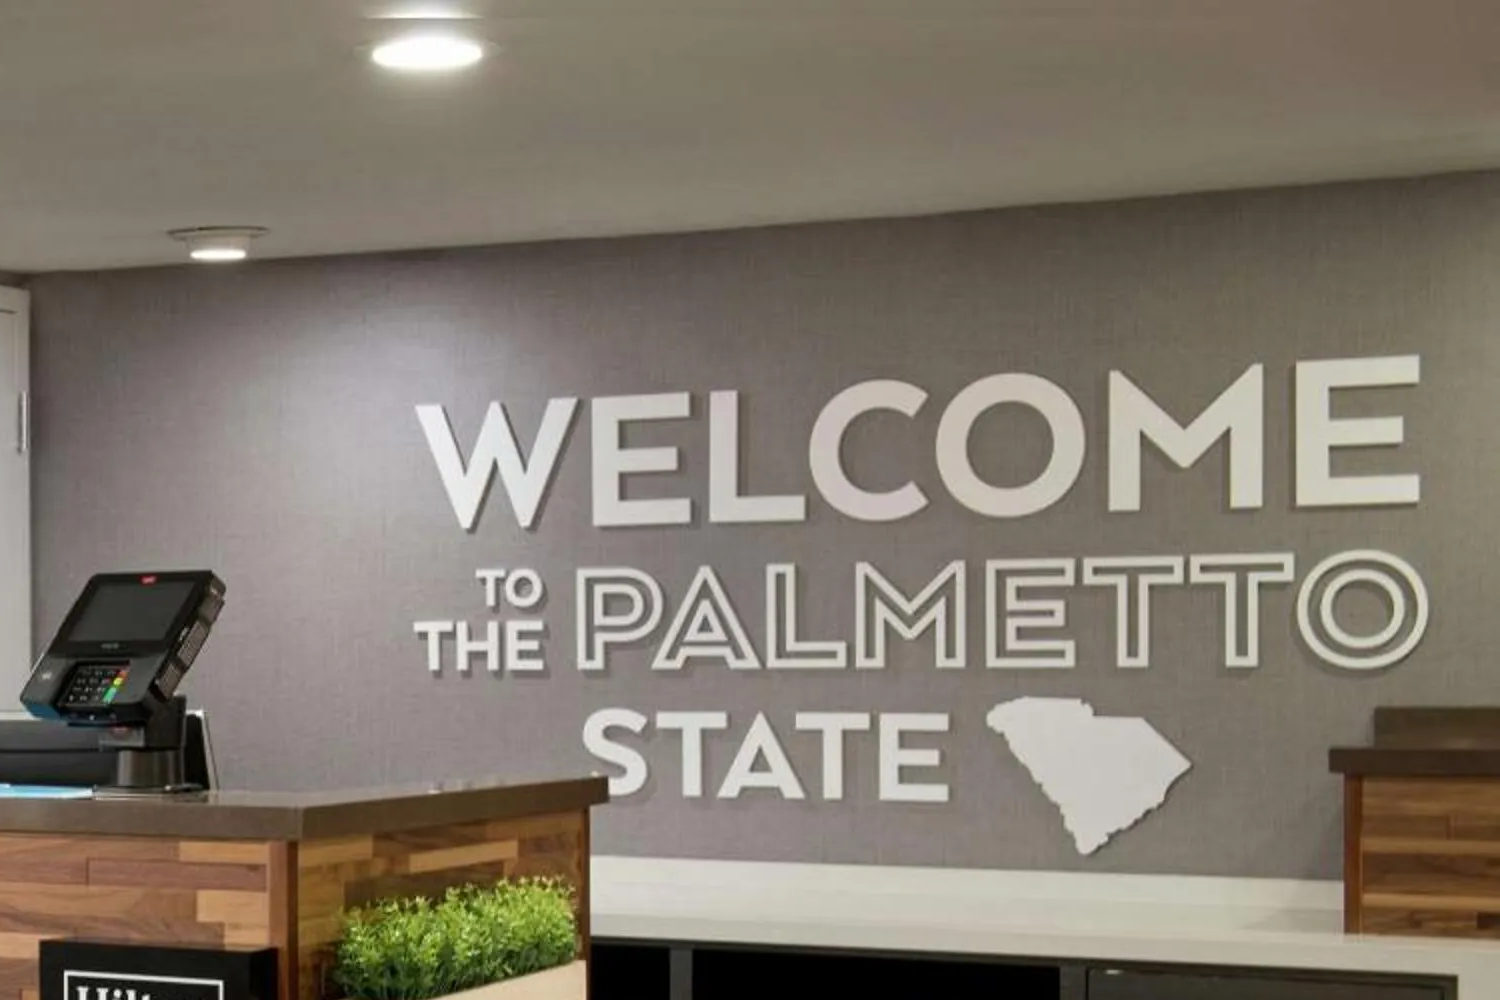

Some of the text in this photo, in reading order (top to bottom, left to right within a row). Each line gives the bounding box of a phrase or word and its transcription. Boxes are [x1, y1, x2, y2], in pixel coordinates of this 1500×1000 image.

[414, 354, 1423, 532] WELCOME
[413, 549, 1429, 672] THE PALMETTO
[475, 568, 544, 608] TO
[582, 707, 951, 802] STATE
